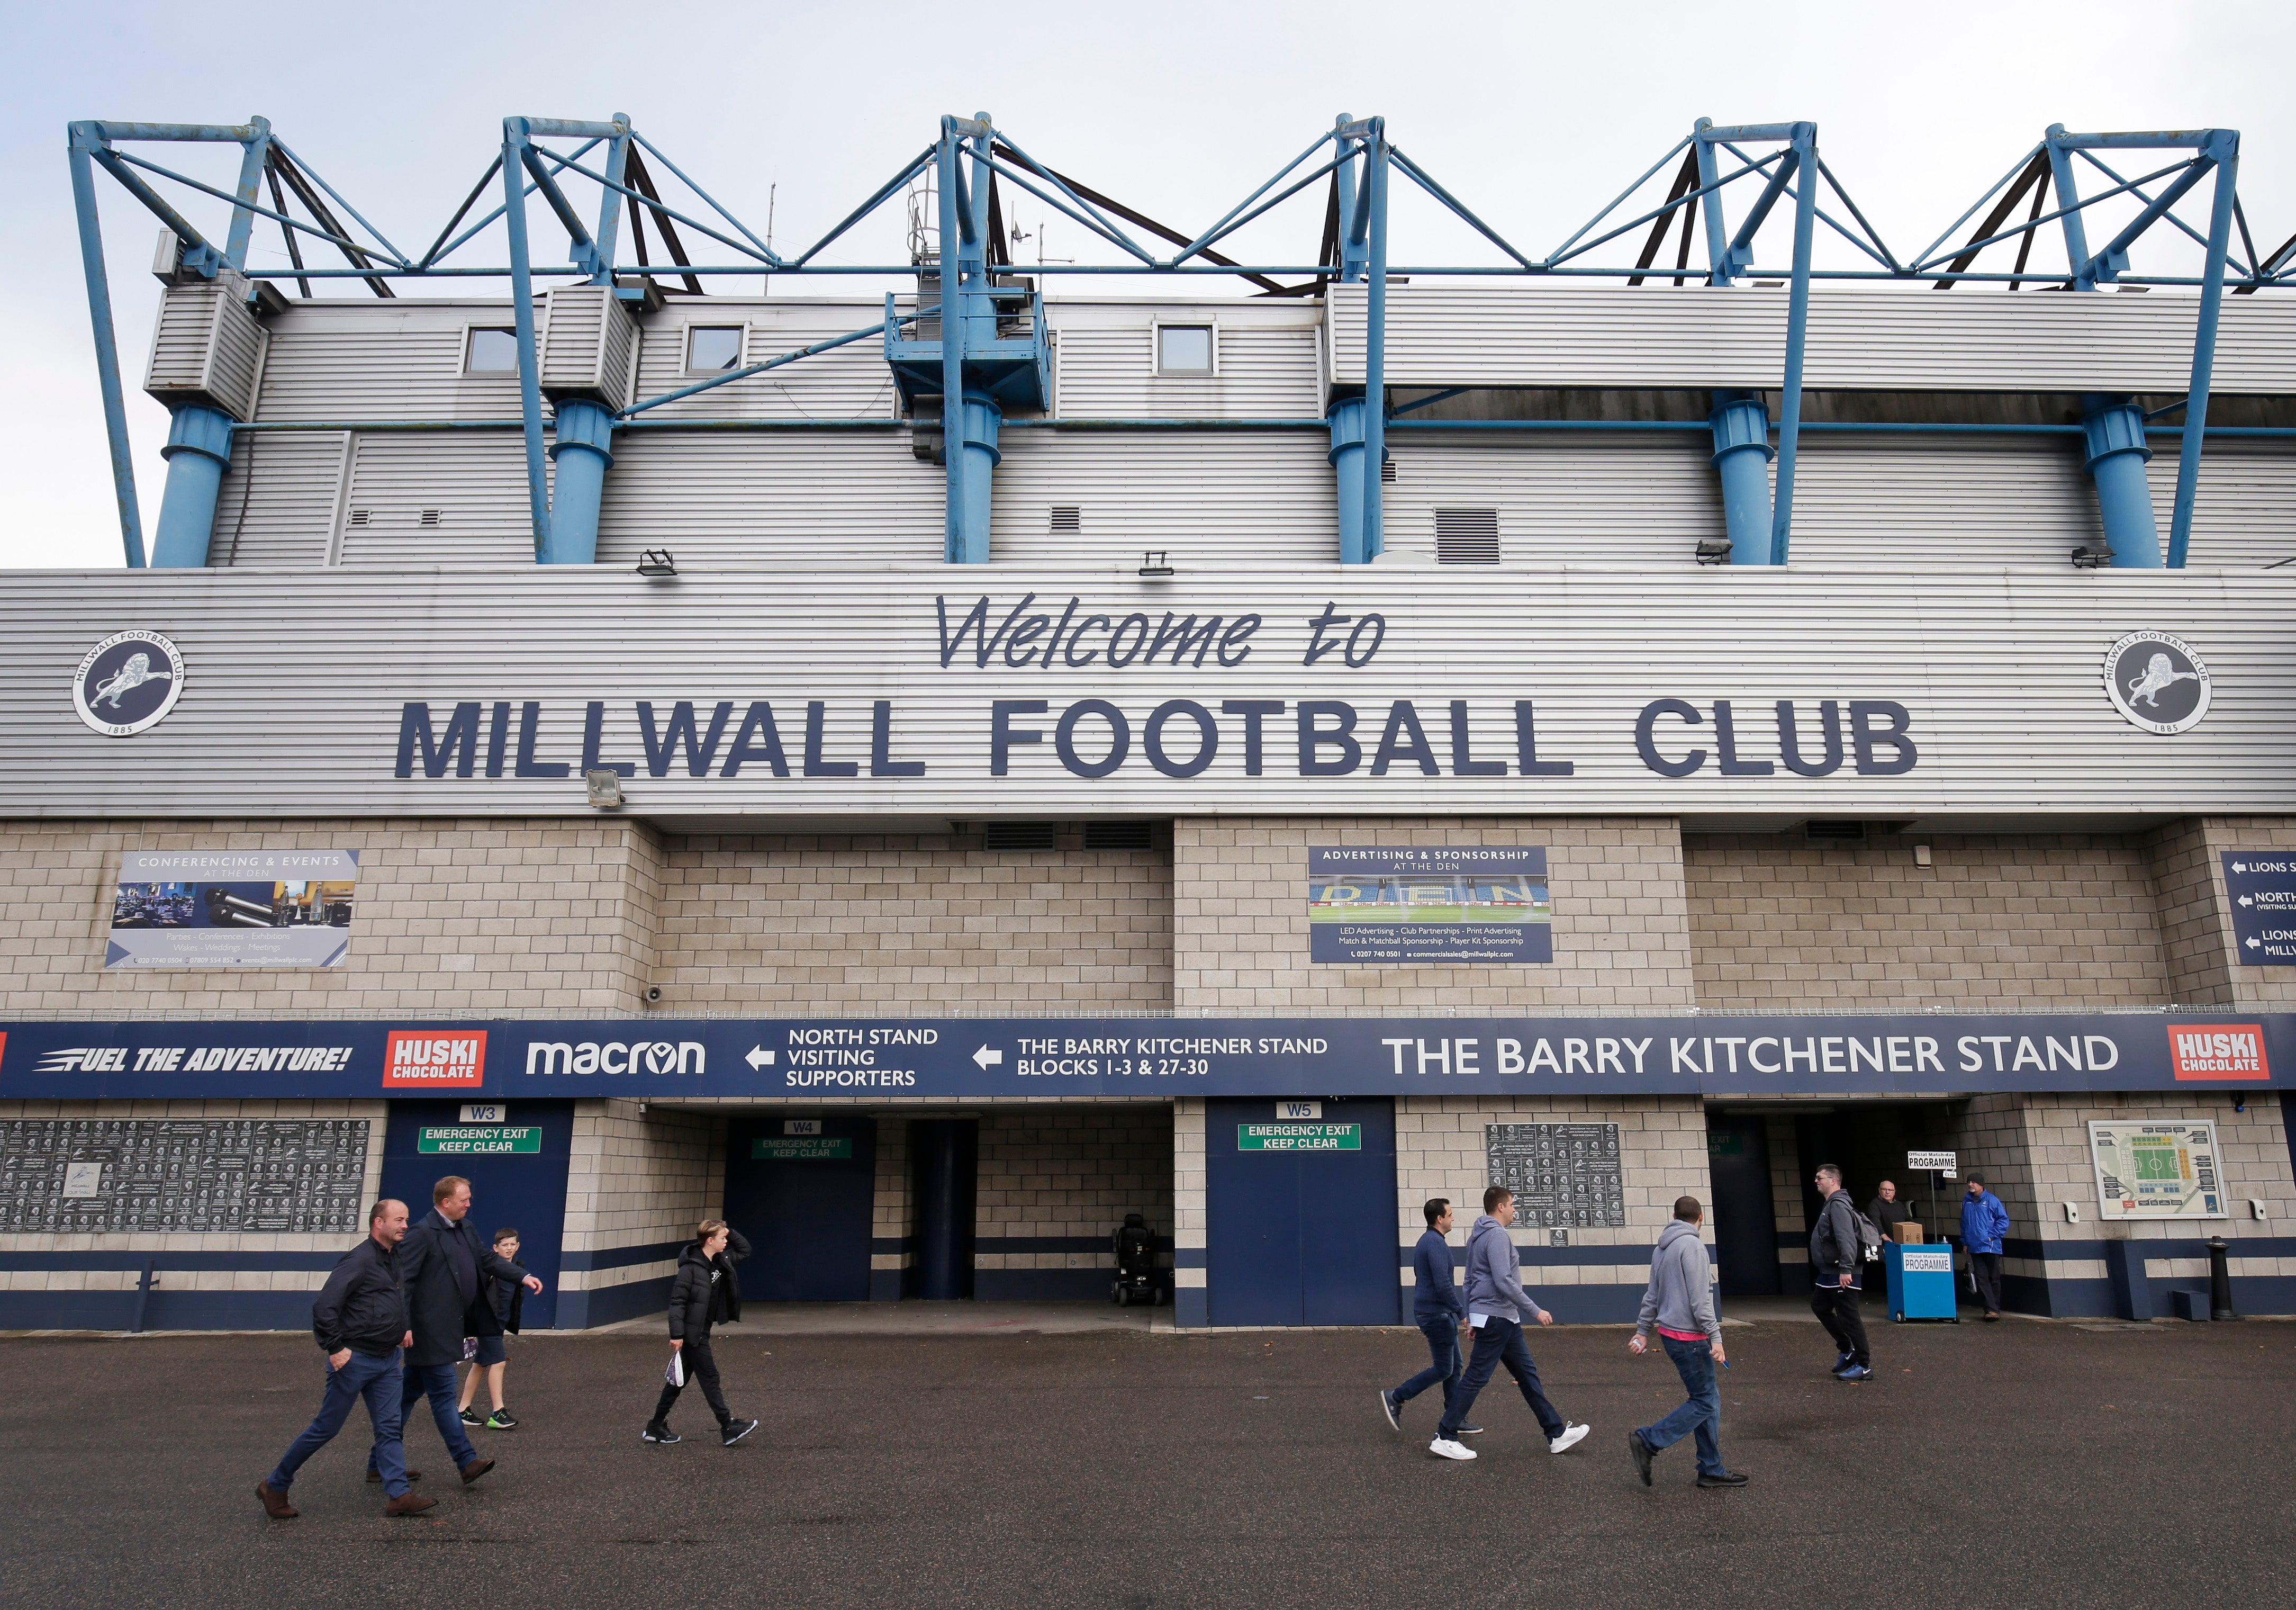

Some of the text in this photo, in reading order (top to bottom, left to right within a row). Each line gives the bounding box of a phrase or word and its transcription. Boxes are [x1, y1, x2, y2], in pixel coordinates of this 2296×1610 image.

[938, 595, 1384, 667] Welcome to
[76, 632, 183, 681] MILLWALL FOOTBALL CLUB
[2107, 633, 2208, 681] MILLWALL FOOTBALL CLUB
[396, 700, 1915, 777] MILLWALL FOOTBALL CLUB
[139, 858, 258, 866] CONFERENCING
[283, 857, 339, 865] EVENTS
[2249, 862, 2286, 872] LIONS
[205, 944, 240, 952] Weddings
[248, 943, 280, 952] Meetings
[1483, 937, 1523, 946] Sponsorship
[790, 1029, 937, 1044] NORTH STAND
[393, 1039, 477, 1065] HUSKI
[1018, 1039, 1327, 1054] THE BARRY KITCHENER STAND
[2176, 1033, 2258, 1058] HUSKI
[32, 1047, 353, 1071] FUEL THE ADVENTURE!
[526, 1041, 706, 1074] macron
[788, 1050, 874, 1065] VISITING
[1382, 1036, 2118, 1074] THE BARRY KITCHENER STAND
[392, 1066, 474, 1078] CHOCOLATE
[1018, 1059, 1208, 1075] BLOCKS 1-3 & 27-30
[2181, 1058, 2261, 1072] CHOCOLATE
[787, 1071, 915, 1086] SUPPORTERS
[471, 1106, 496, 1121] W3
[1286, 1103, 1312, 1117] W5
[425, 1128, 529, 1139] EMERGENCY EXIT
[792, 1121, 813, 1133] W4
[1249, 1125, 1352, 1136] EMERGENCY EXIT
[438, 1141, 513, 1152] KEEP CLEAR
[763, 1139, 842, 1149] EMERGENCY EXIT
[1263, 1138, 1338, 1149] KEEP CLEAR
[773, 1148, 830, 1158] KEEP CLEAR
[1909, 1158, 1955, 1167] PROGRAMME
[1905, 1259, 1949, 1270] PROGRAMME
